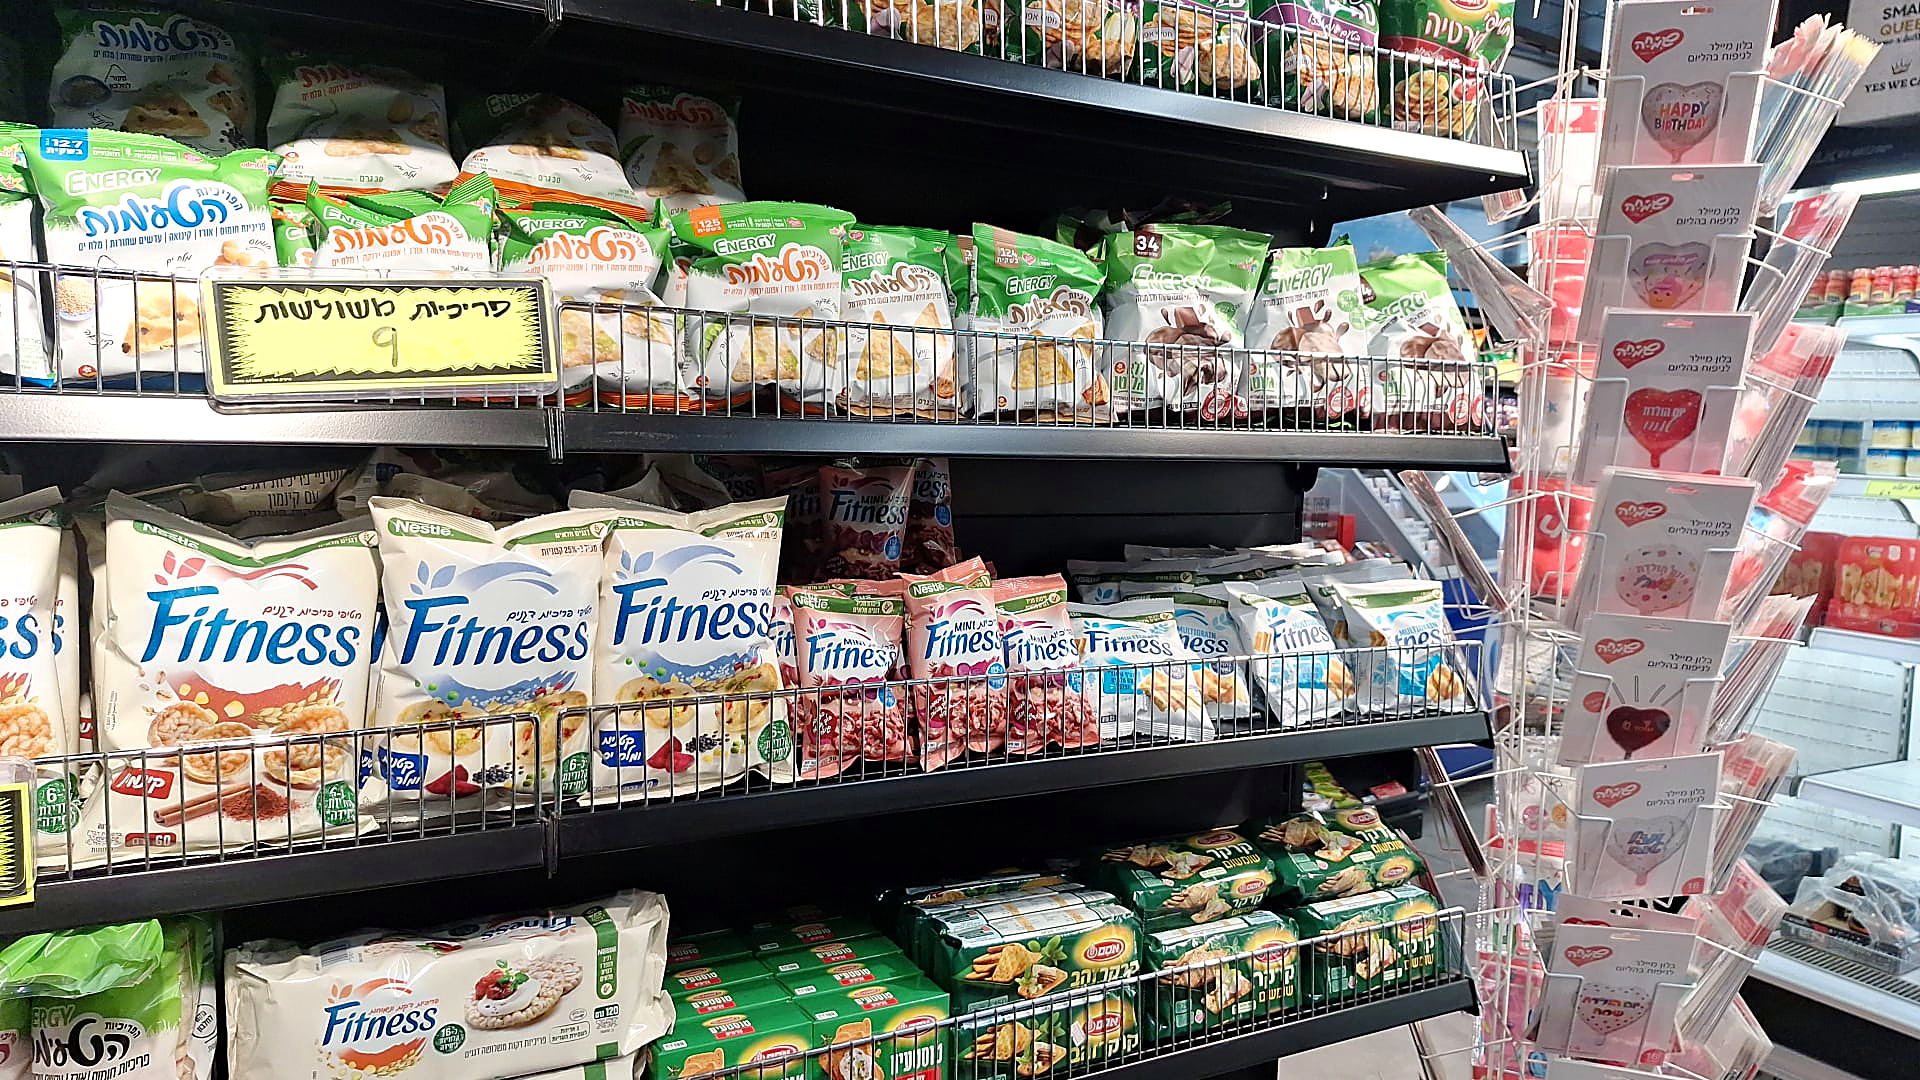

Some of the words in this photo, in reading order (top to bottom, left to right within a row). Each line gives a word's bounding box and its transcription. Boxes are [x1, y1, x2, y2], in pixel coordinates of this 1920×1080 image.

[1883, 3, 1920, 20] SMA
[1634, 32, 1681, 51] שמחה
[1709, 41, 1733, 51] מיילר
[1736, 41, 1753, 52] בלון
[1687, 53, 1719, 63] בהליום
[1721, 51, 1752, 61] לניפוח
[1865, 83, 1886, 93] YES
[1887, 79, 1908, 90] WE
[1660, 101, 1710, 117] HAPPY
[1654, 117, 1710, 132] BIRTHDAY
[52, 138, 83, 149] 127
[46, 147, 84, 156] בשקית
[69, 170, 159, 193] ENERGY
[196, 187, 244, 212] הפריכיות
[1624, 196, 1670, 213] שמחה
[82, 185, 228, 237] הטעימות
[1698, 207, 1721, 216] מיילר
[1723, 207, 1740, 216] בלון
[517, 217, 587, 235] ENERGY
[698, 219, 721, 228] 125
[1676, 217, 1707, 225] בהליום
[1709, 216, 1739, 225] לניפוח
[169, 231, 192, 242] קינואה
[199, 228, 214, 239] אורז
[220, 225, 240, 236] חומוס
[334, 219, 451, 253] הטעימות
[78, 241, 87, 251] ים
[88, 239, 103, 250] מלח
[110, 236, 137, 249] שחורות
[138, 233, 162, 246] עדשים
[612, 231, 648, 254] הפריכיות
[714, 233, 776, 256] ENERGY
[1135, 236, 1160, 251] 34
[528, 229, 637, 265] הטעימות
[727, 248, 820, 285] הטעימות
[801, 248, 830, 271] הפריכיות
[842, 251, 888, 273] ENERGY
[851, 265, 931, 296] הטעימות
[1006, 275, 1057, 296] ENERGY
[1263, 264, 1332, 295] ENERGY
[254, 298, 396, 324] משולשות
[410, 300, 512, 321] פריכיות
[372, 326, 399, 368] 9
[1616, 341, 1662, 358] שמחה
[1689, 354, 1713, 363] מיילר
[1715, 354, 1732, 364] בלון
[1668, 363, 1699, 372] בהליום
[1701, 364, 1731, 373] לניפוח
[268, 491, 301, 509] קינמון
[304, 490, 319, 505] עם
[828, 489, 907, 525] Fitness
[1618, 505, 1664, 518] שמחה
[1690, 519, 1713, 528] מיילר
[1715, 519, 1732, 529] בלון
[1668, 526, 1699, 536] בהליום
[1701, 528, 1730, 537] לניפוח
[702, 588, 728, 601] דגנים
[729, 587, 758, 598] פריכיות
[262, 605, 296, 618] דגנים
[298, 608, 334, 620] פריכיות
[506, 610, 536, 623] דגנים
[538, 608, 573, 620] פריכיות
[612, 577, 771, 645] Fitness
[141, 585, 361, 667] Fitness
[400, 595, 588, 667] Fitness
[954, 620, 976, 632] MINI
[1002, 630, 1079, 669] Fitness
[1083, 630, 1173, 656] Fitness
[1597, 641, 1640, 654] שמחה
[806, 632, 897, 673] Fitness
[1670, 652, 1693, 662] מיילר
[1696, 655, 1713, 664] בלון
[1647, 660, 1679, 670] בהליום
[1681, 663, 1711, 673] לניפוח
[1595, 783, 1637, 799] שמחה
[1206, 842, 1254, 859] קרקר
[1223, 853, 1261, 869] שומשום
[481, 915, 577, 940] Fitness
[1096, 942, 1122, 957] אסם
[1070, 969, 1097, 988] זהב
[605, 1006, 618, 1015] 120
[104, 1021, 142, 1039] הפריכיות
[322, 1000, 438, 1046] Fitness
